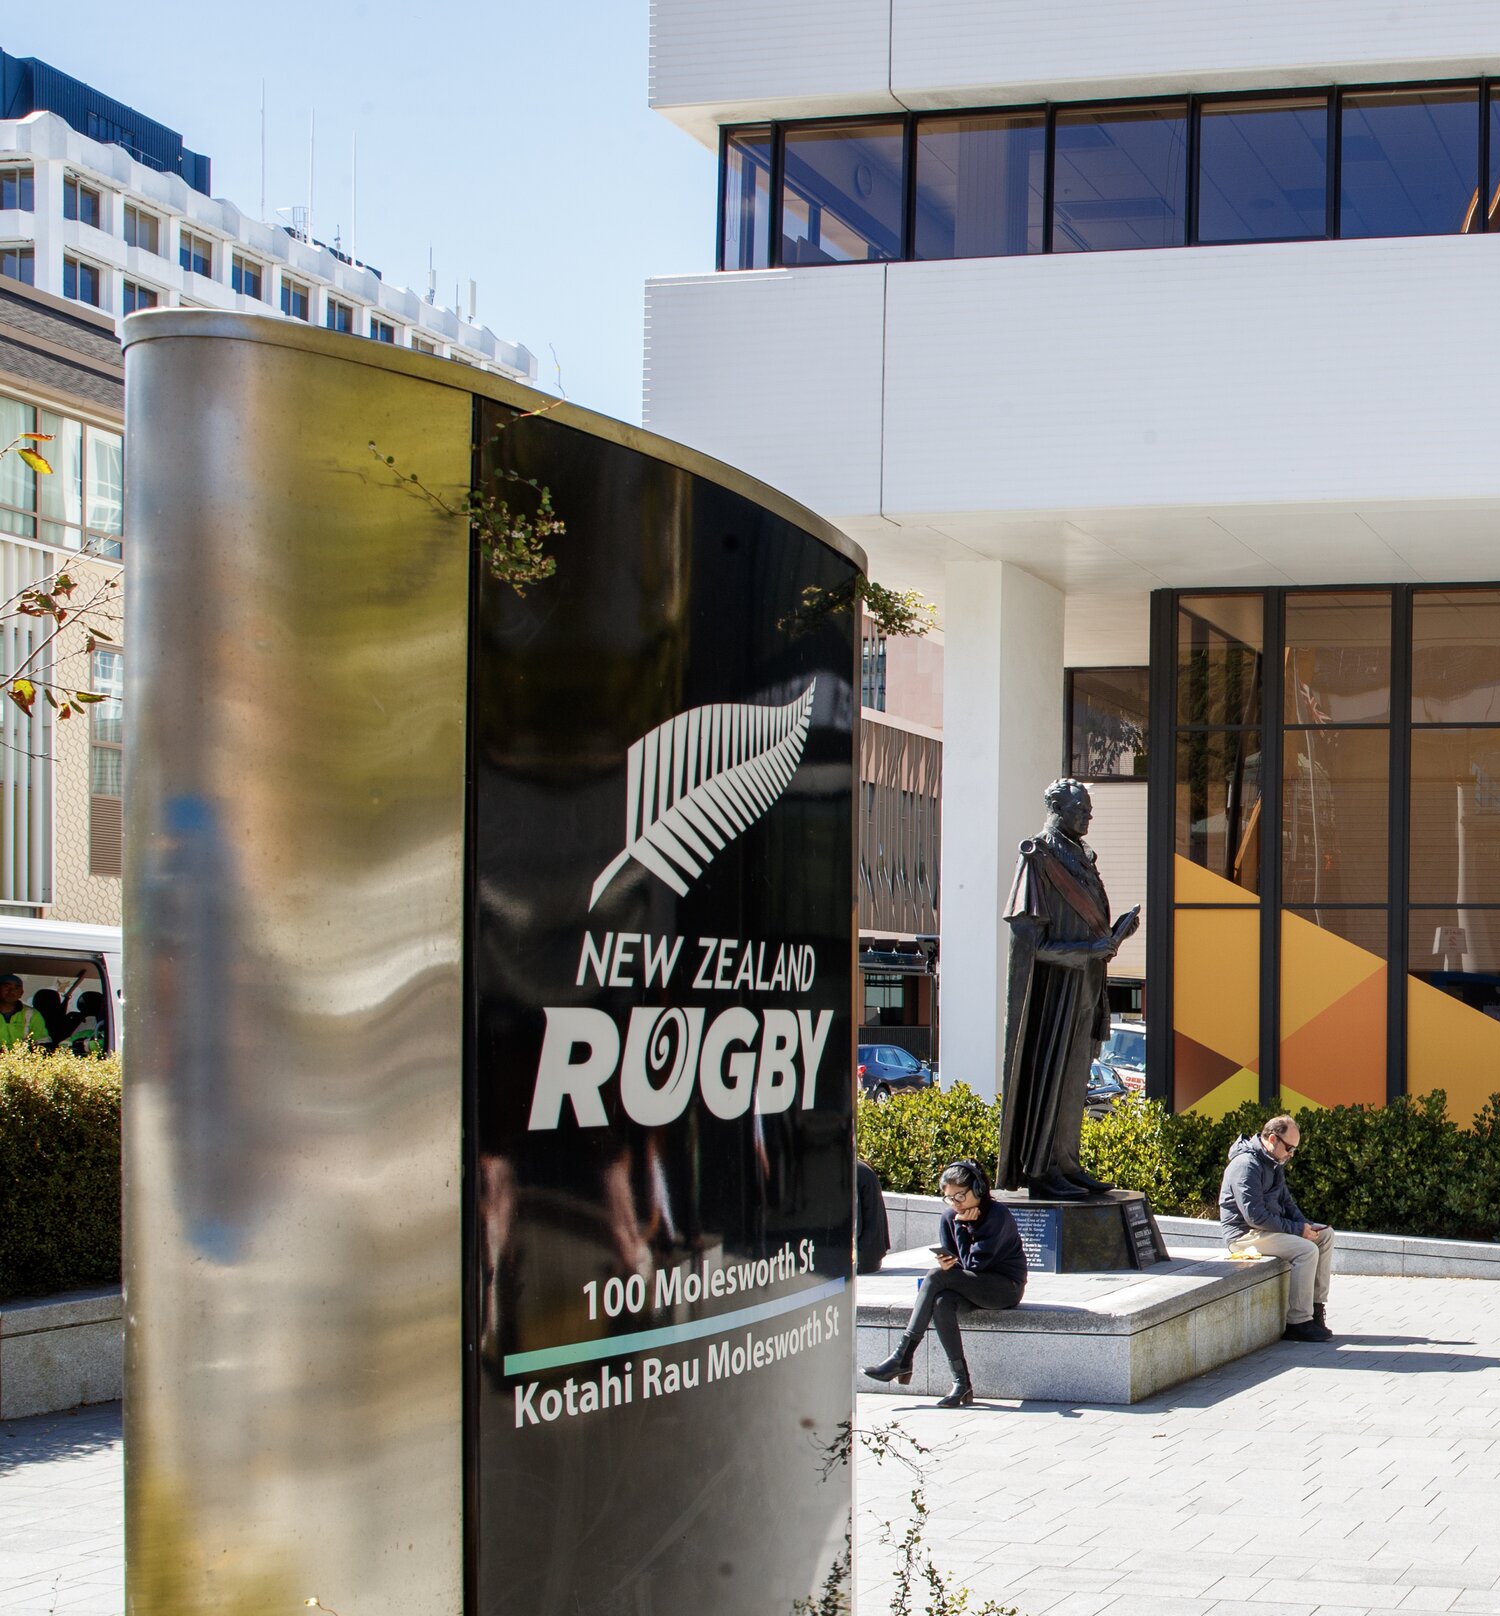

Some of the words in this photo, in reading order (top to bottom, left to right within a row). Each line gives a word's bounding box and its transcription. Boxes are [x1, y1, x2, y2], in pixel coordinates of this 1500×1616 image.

[576, 931, 684, 988] NEW
[693, 937, 815, 991] ZEALAND
[528, 1006, 834, 1131] RUGBY
[583, 1273, 645, 1320] 100
[655, 1243, 796, 1309] Molesworth
[800, 1239, 815, 1273] St
[514, 1362, 632, 1428] Kotahi
[643, 1358, 699, 1399] Rau
[707, 1315, 822, 1382] Molesworth
[825, 1305, 840, 1338] St
